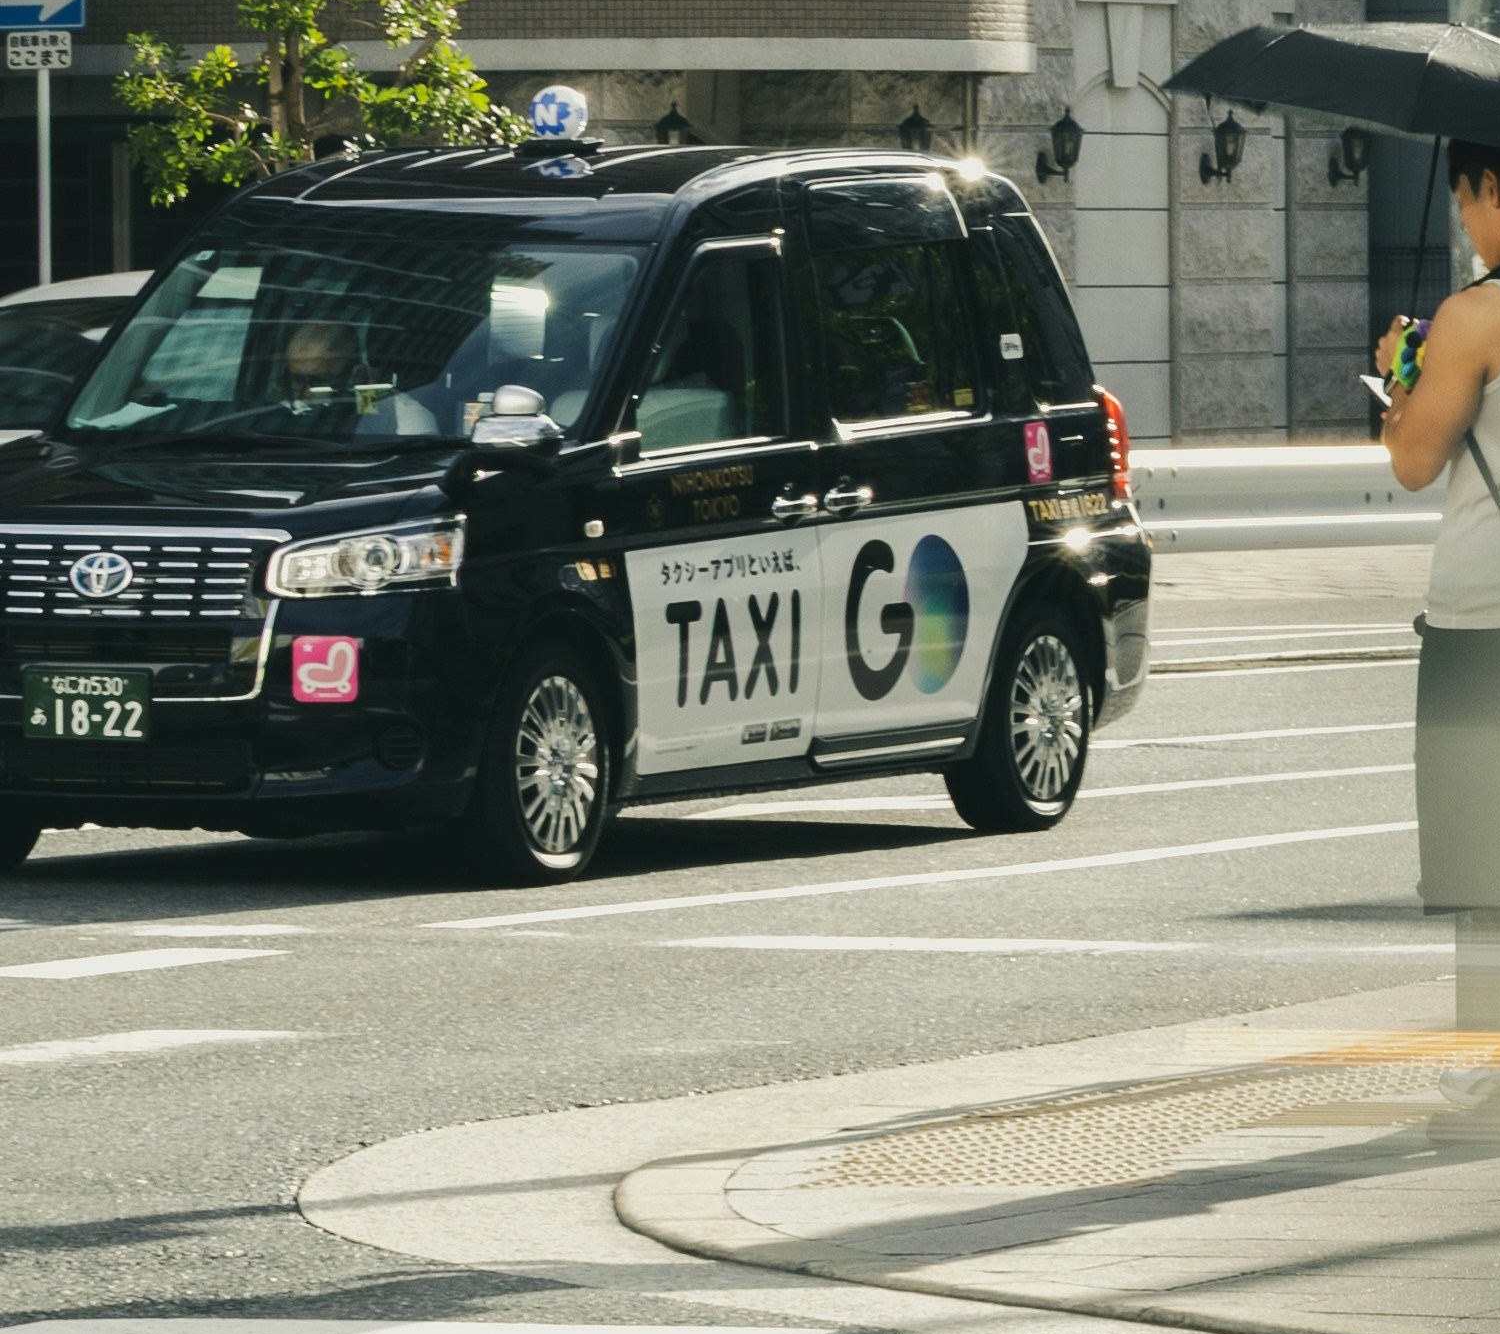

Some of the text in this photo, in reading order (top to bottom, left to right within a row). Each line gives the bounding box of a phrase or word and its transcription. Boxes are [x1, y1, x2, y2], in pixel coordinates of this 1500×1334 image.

[9, 49, 69, 66] ここまで
[535, 103, 558, 126] N
[665, 534, 970, 708] TAXI GO
[55, 698, 143, 738] 18-22
